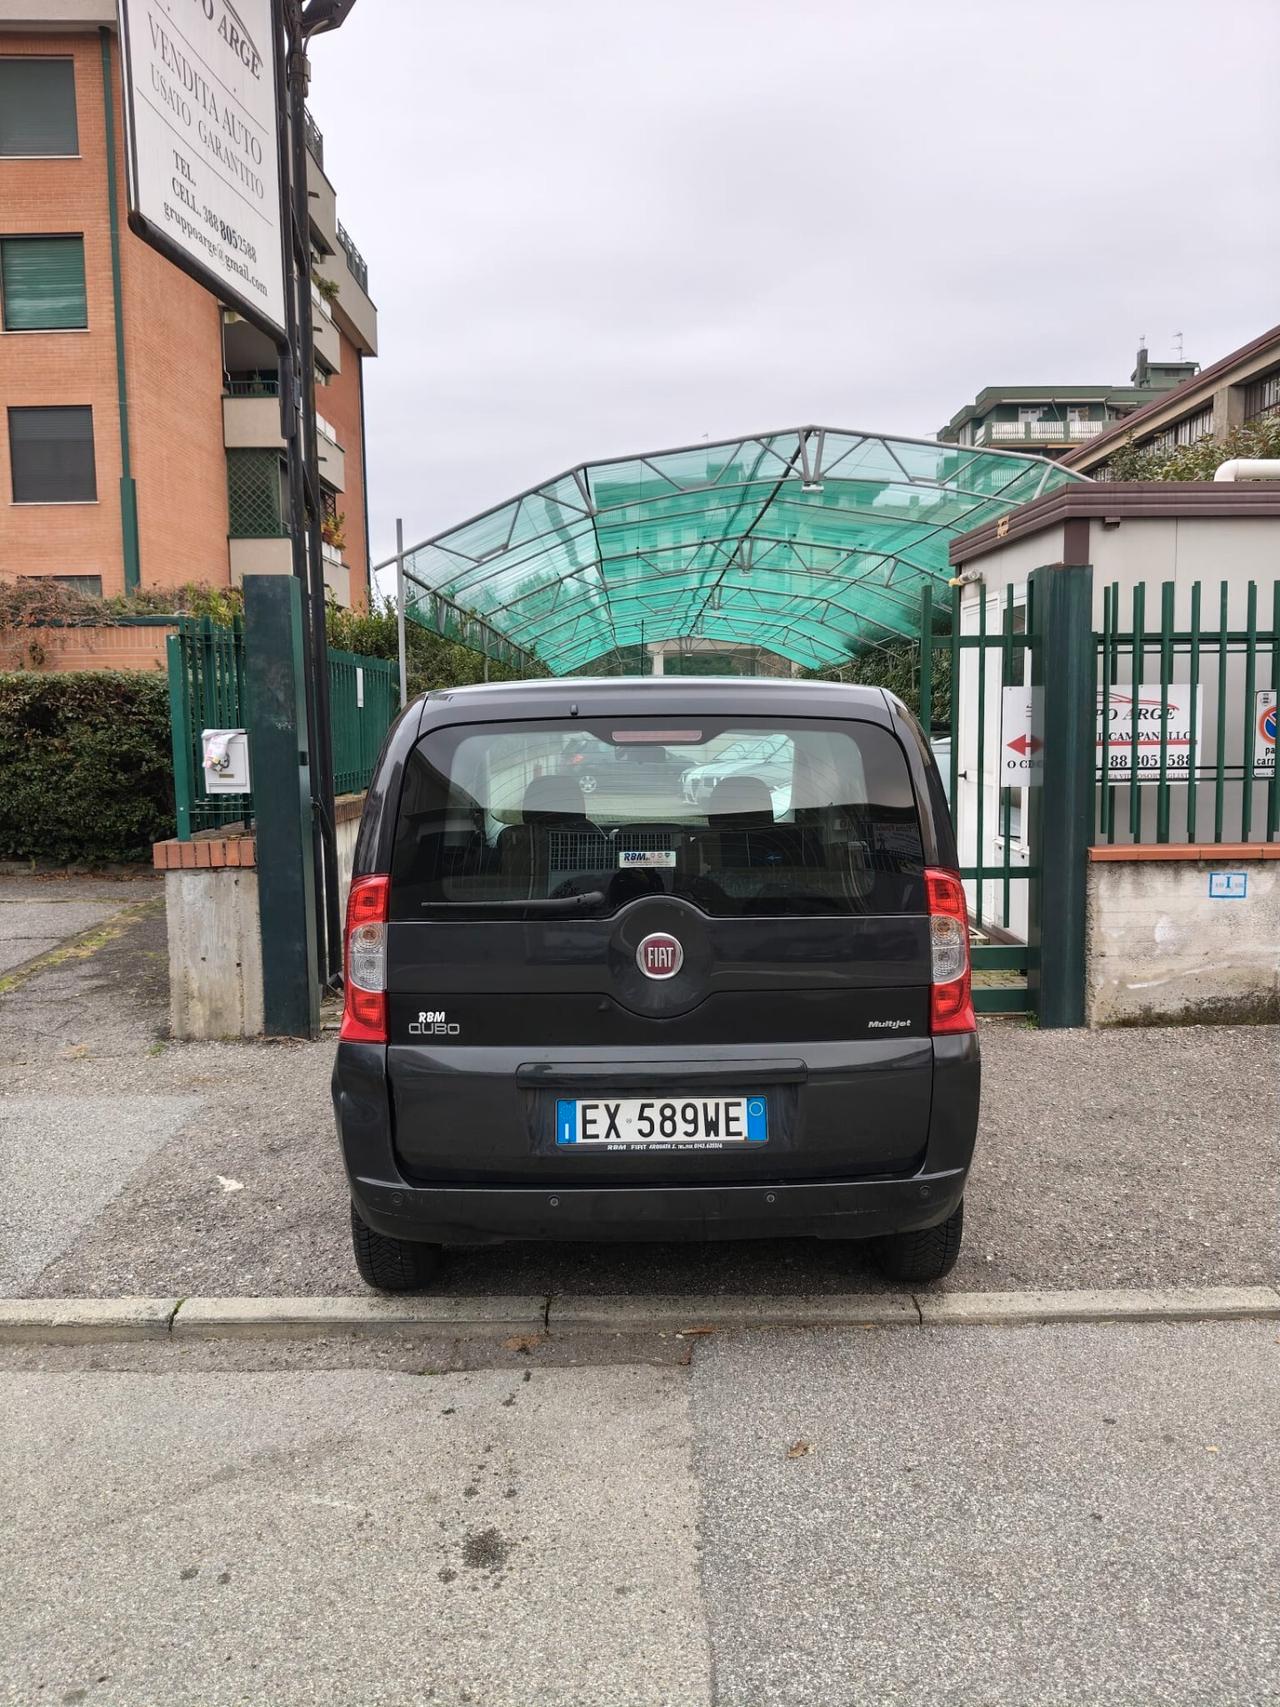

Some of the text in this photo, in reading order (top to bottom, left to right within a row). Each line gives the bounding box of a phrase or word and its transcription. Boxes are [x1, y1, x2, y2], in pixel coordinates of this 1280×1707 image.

[217, 14, 260, 80] ARGE
[148, 11, 262, 165] VENDITA AUTO
[150, 62, 264, 199] USATO GARANTITO
[163, 201, 268, 297] gruppoarge@gmail.com
[1122, 707, 1175, 720] ARGE
[1108, 731, 1191, 741] CAMPANLLO
[1256, 758, 1275, 766] carr
[623, 852, 647, 862] RBM
[647, 947, 674, 968] FIAT
[418, 1011, 446, 1023] RBM
[408, 1022, 460, 1035] QUBO
[867, 1019, 912, 1030] Multijet
[581, 1103, 622, 1139] EX
[637, 1101, 743, 1138] 589WE
